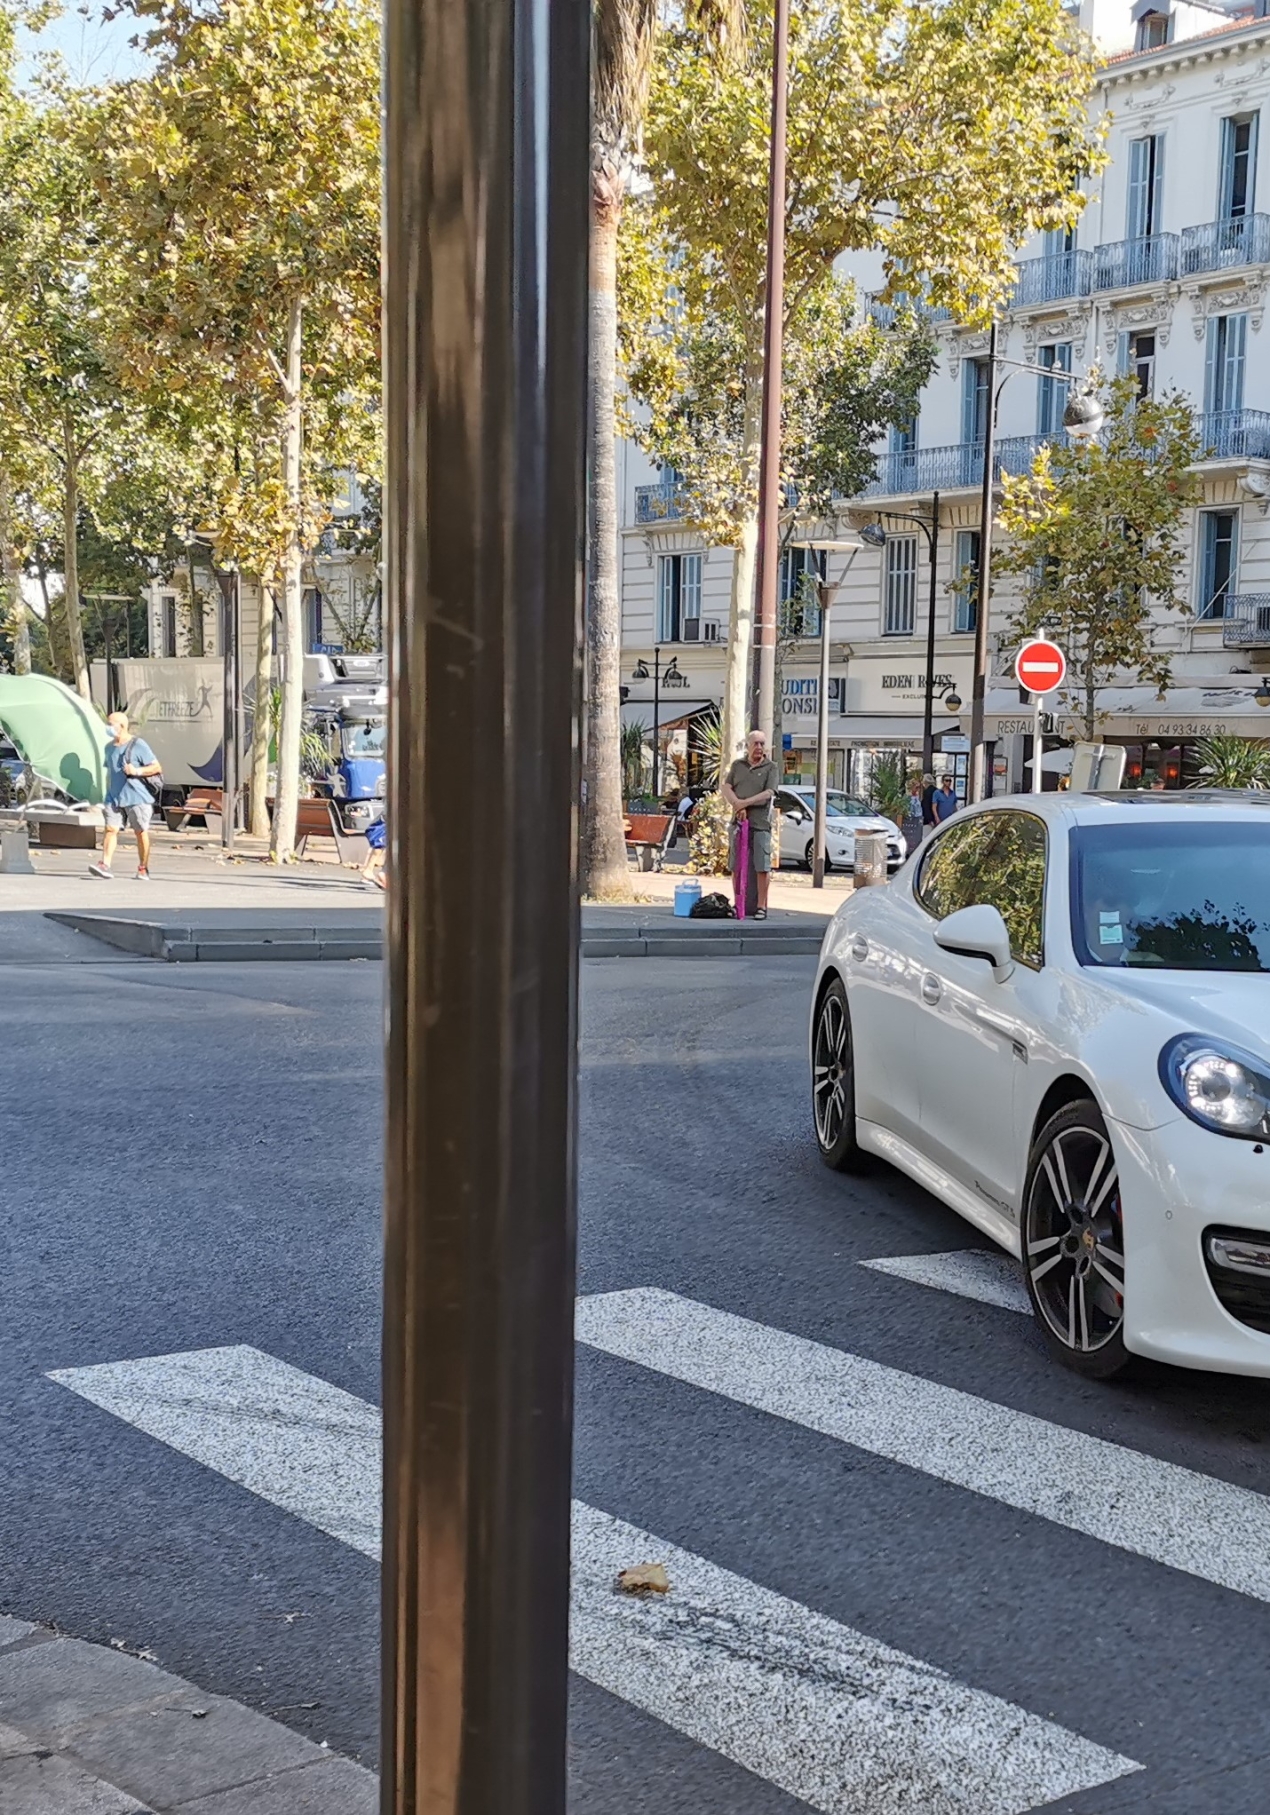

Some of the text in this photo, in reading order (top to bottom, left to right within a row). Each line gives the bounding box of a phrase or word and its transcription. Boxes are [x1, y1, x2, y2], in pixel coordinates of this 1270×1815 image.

[881, 674, 913, 689] EDEN
[1158, 724, 1169, 735] 04
[1172, 724, 1184, 735] 93
[1186, 724, 1198, 735] 34
[1199, 724, 1211, 735] 86
[1213, 724, 1226, 735] 30
